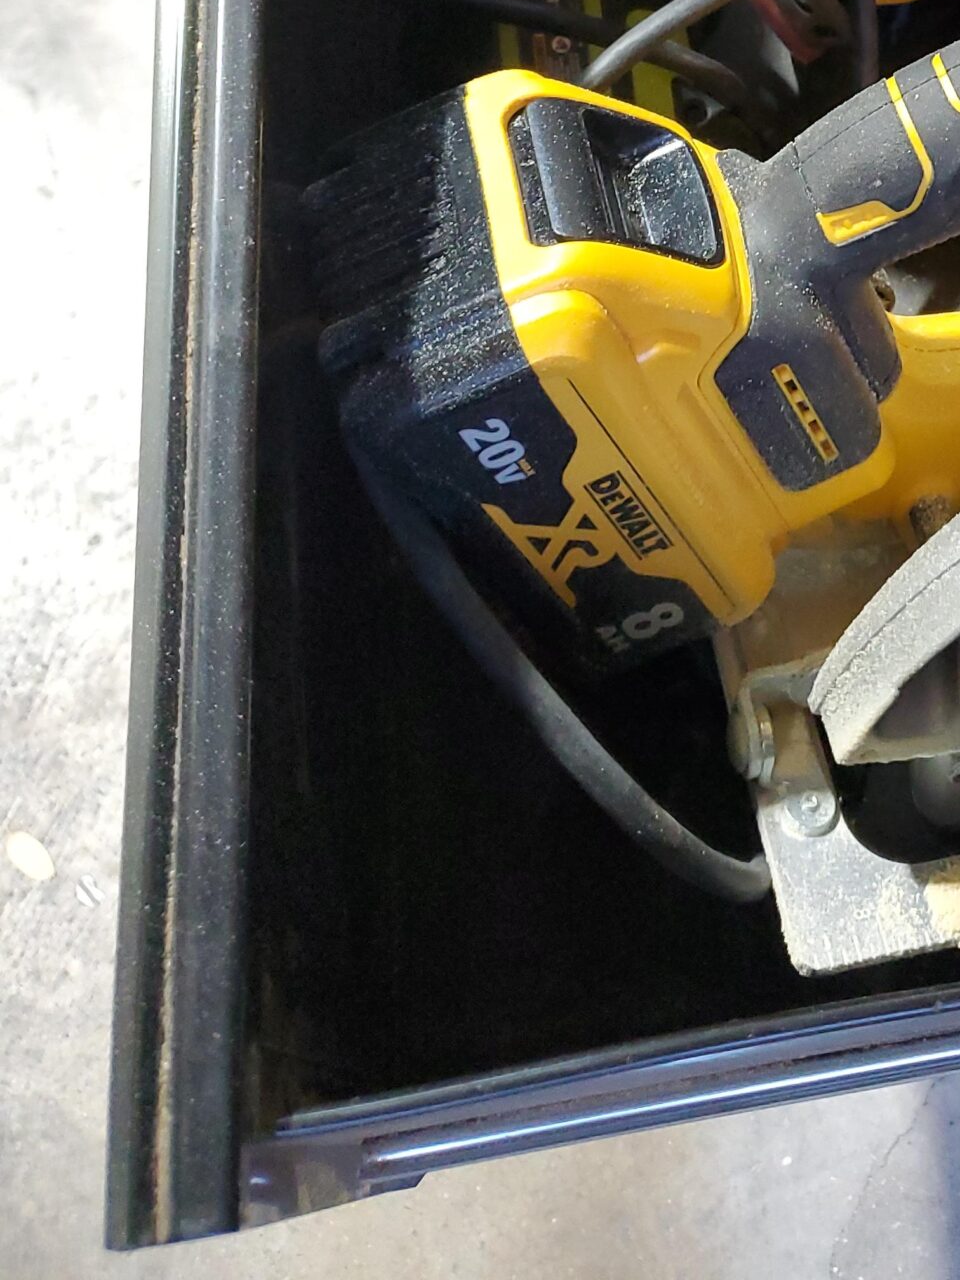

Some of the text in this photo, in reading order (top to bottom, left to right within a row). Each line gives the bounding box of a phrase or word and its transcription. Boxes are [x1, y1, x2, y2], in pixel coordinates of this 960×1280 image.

[458, 418, 528, 485] 20V
[590, 472, 672, 556] DEWALT
[621, 602, 685, 640] 8
